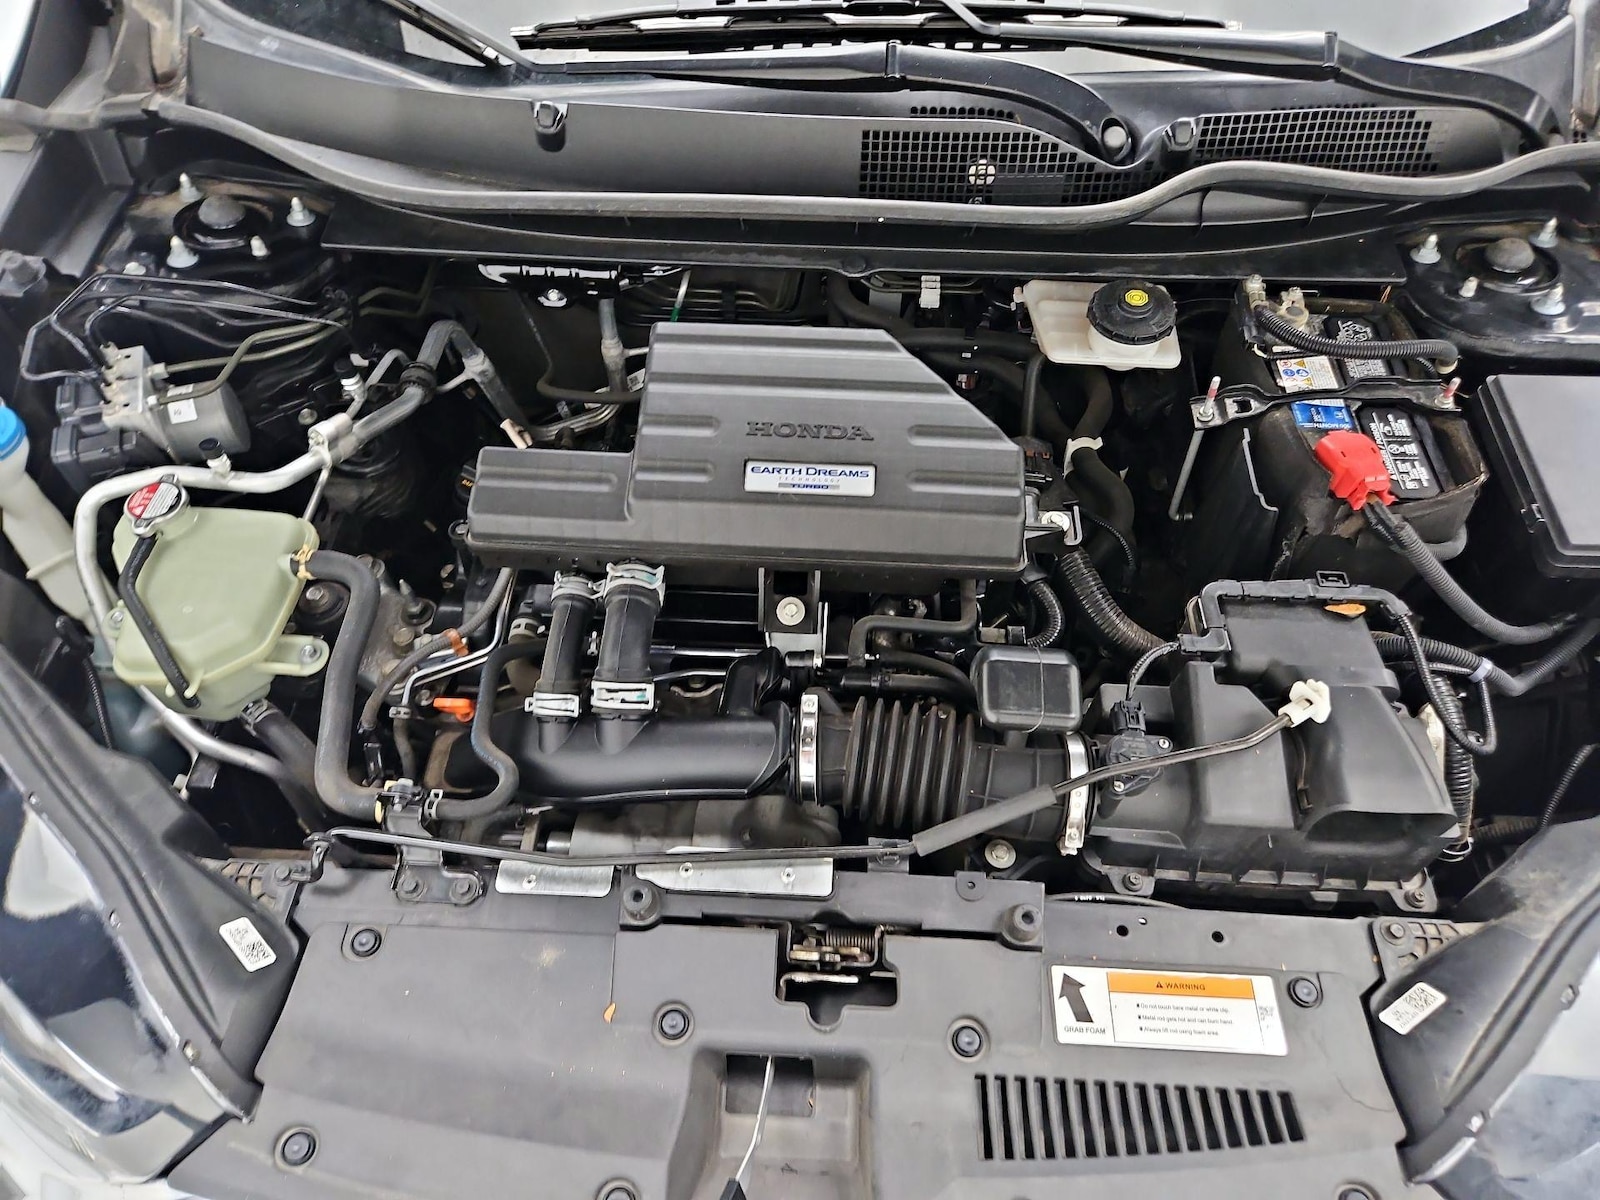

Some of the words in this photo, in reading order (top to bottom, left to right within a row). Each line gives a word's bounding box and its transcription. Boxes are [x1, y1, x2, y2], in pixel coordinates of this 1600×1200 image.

[746, 421, 875, 441] HONDA
[750, 466, 802, 475] EARTH
[805, 466, 869, 478] DREAMS
[1166, 982, 1206, 991] WARNING
[1064, 1025, 1084, 1033] GRAB
[1086, 1026, 1106, 1035] FOAM
[1144, 1026, 1161, 1034] Always
